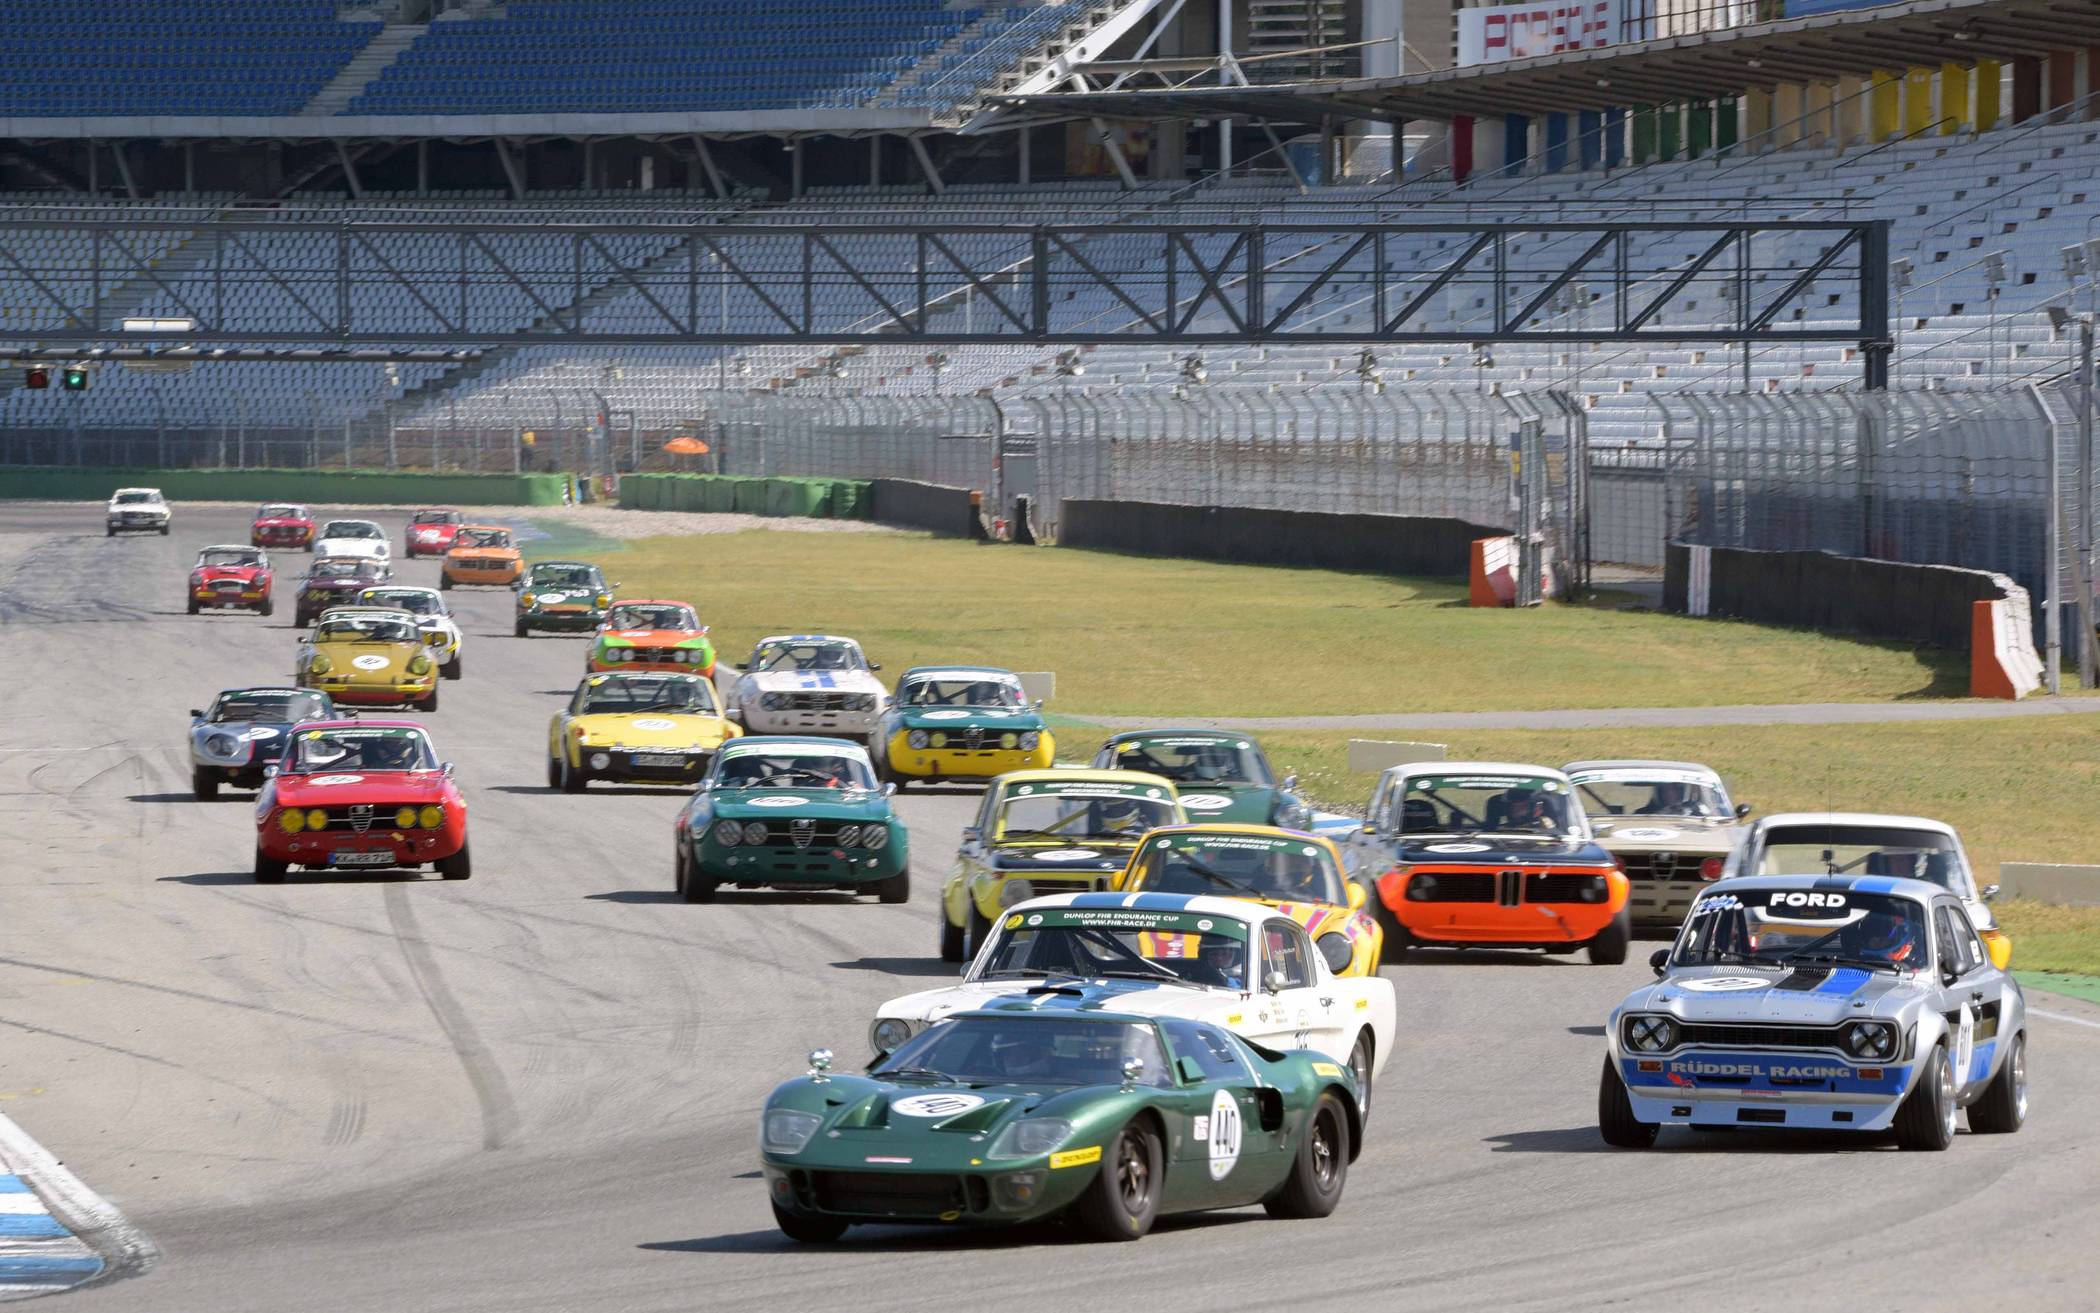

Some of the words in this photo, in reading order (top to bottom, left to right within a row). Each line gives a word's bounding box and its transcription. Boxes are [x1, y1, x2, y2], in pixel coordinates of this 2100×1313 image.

[1769, 892, 1847, 908] FORD
[1082, 919, 1157, 928] WWW.FHR-RACE.DE
[1113, 912, 1161, 921] ENDURANCE
[1670, 1060, 1766, 1076] RÜDDEL
[1770, 1066, 1850, 1078] RACING
[1215, 1109, 1236, 1155] 440
